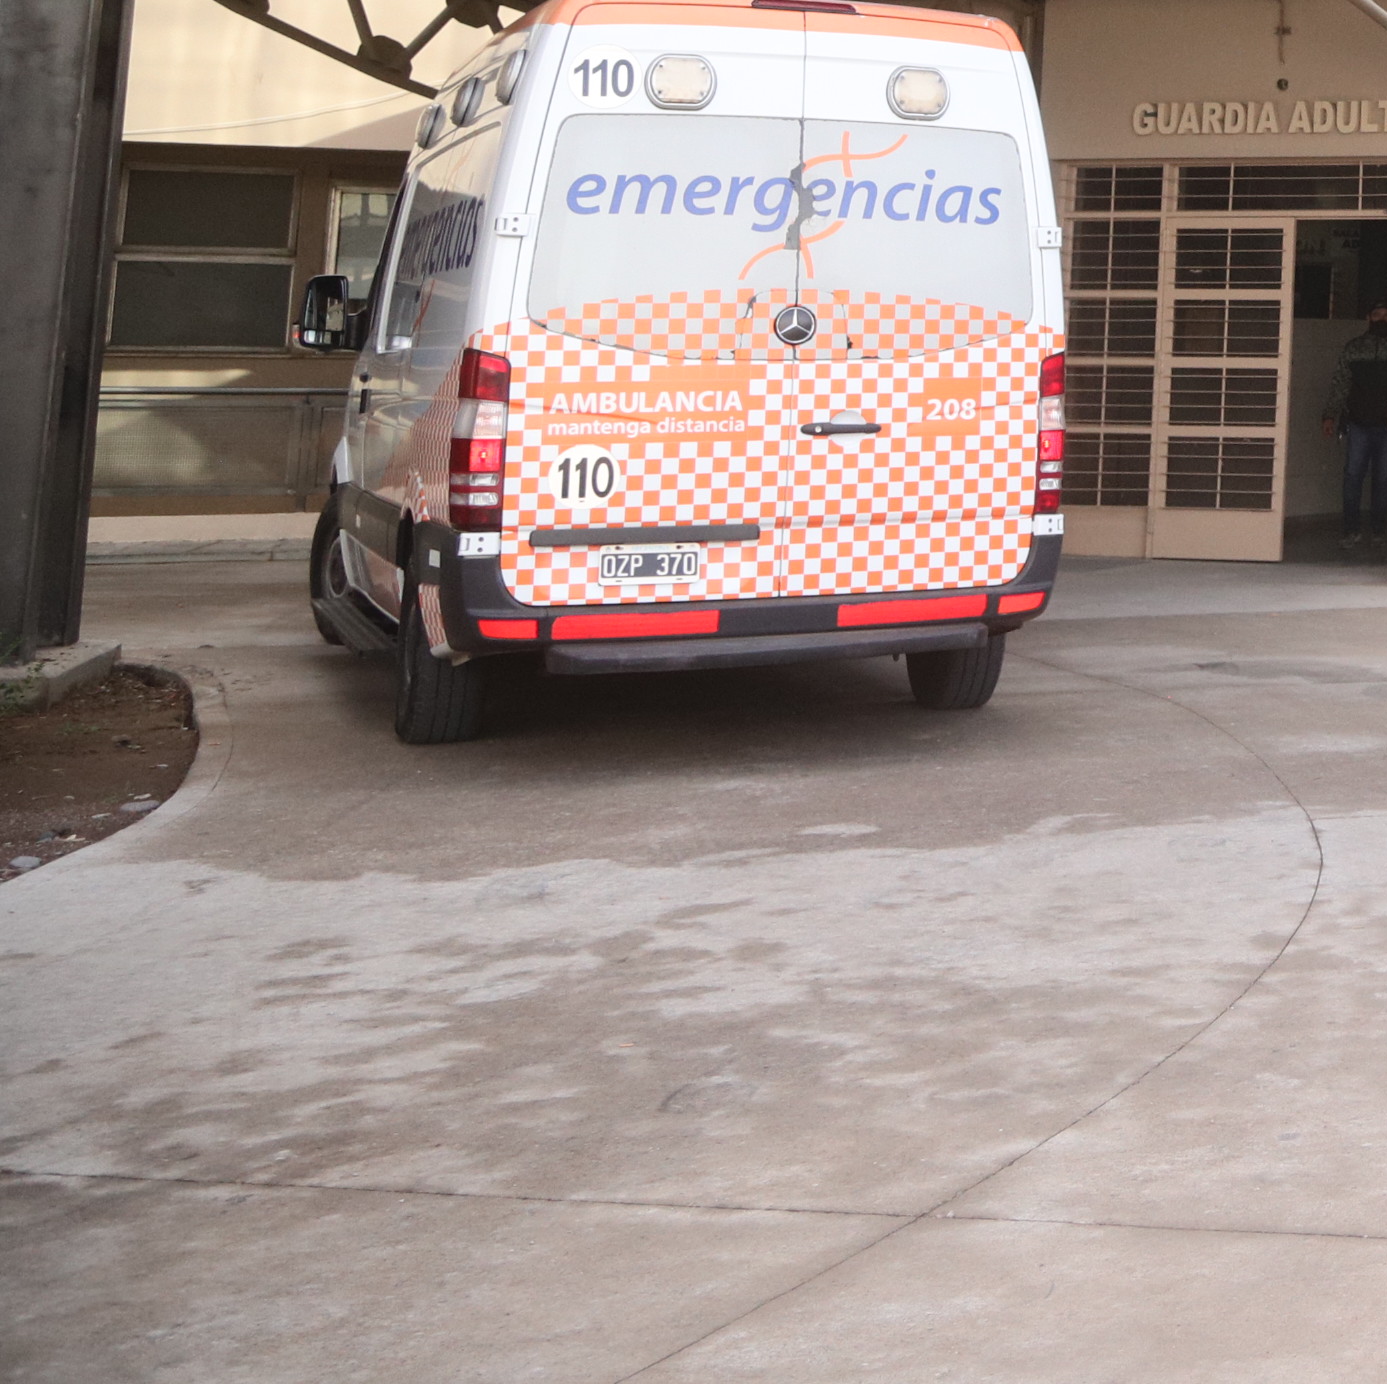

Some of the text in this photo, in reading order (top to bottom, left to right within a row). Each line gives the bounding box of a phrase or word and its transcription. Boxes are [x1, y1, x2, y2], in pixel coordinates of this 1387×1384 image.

[573, 58, 635, 98] 110
[1132, 100, 1280, 136] GUARDIA
[566, 168, 1002, 233] emergencias
[549, 390, 744, 415] AMBULANCIA
[925, 398, 977, 421] 208
[547, 416, 746, 439] mantenga distancia
[557, 456, 615, 499] 110
[602, 553, 696, 577] OZP 370
